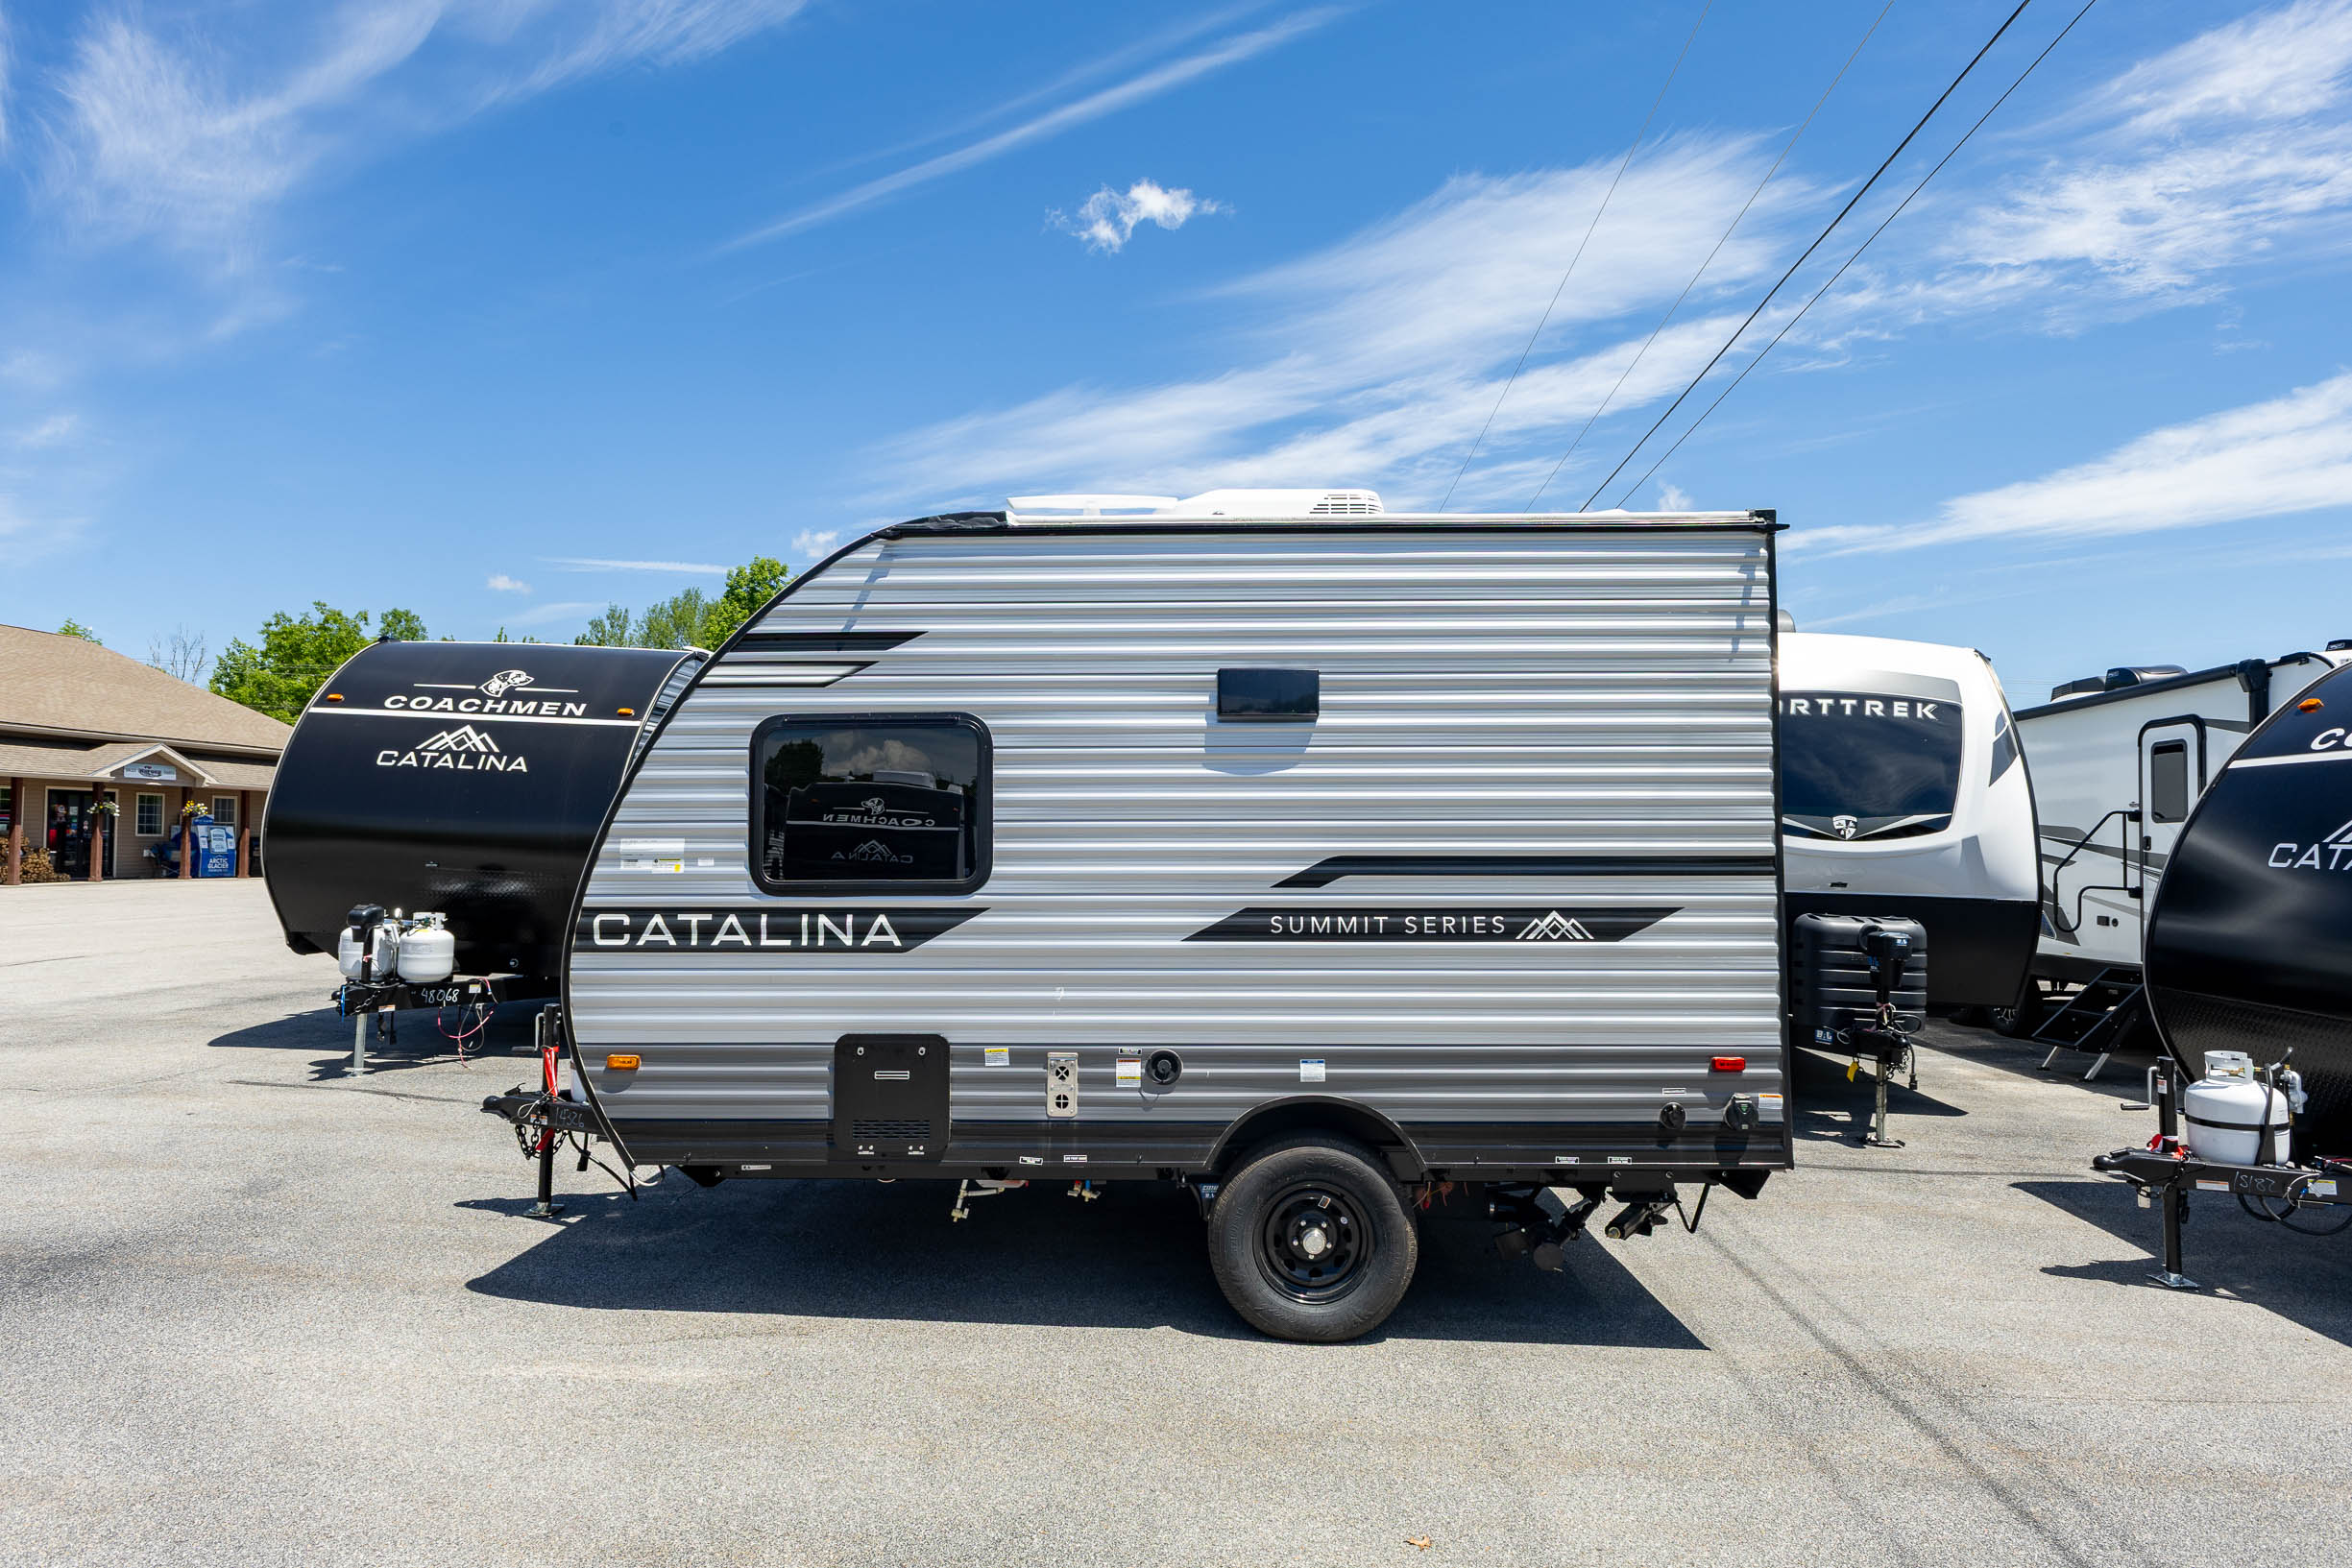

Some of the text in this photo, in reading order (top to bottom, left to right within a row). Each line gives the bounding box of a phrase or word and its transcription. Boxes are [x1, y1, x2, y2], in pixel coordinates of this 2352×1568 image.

[384, 695, 588, 716] COACHMEN
[1778, 698, 1939, 720] RTTREK
[376, 750, 528, 773] CATALINA
[2267, 842, 2352, 871] CAT
[593, 913, 903, 946] CATALINA
[1271, 915, 1506, 934] SUMMIT SERIES
[421, 987, 460, 1003] 48068
